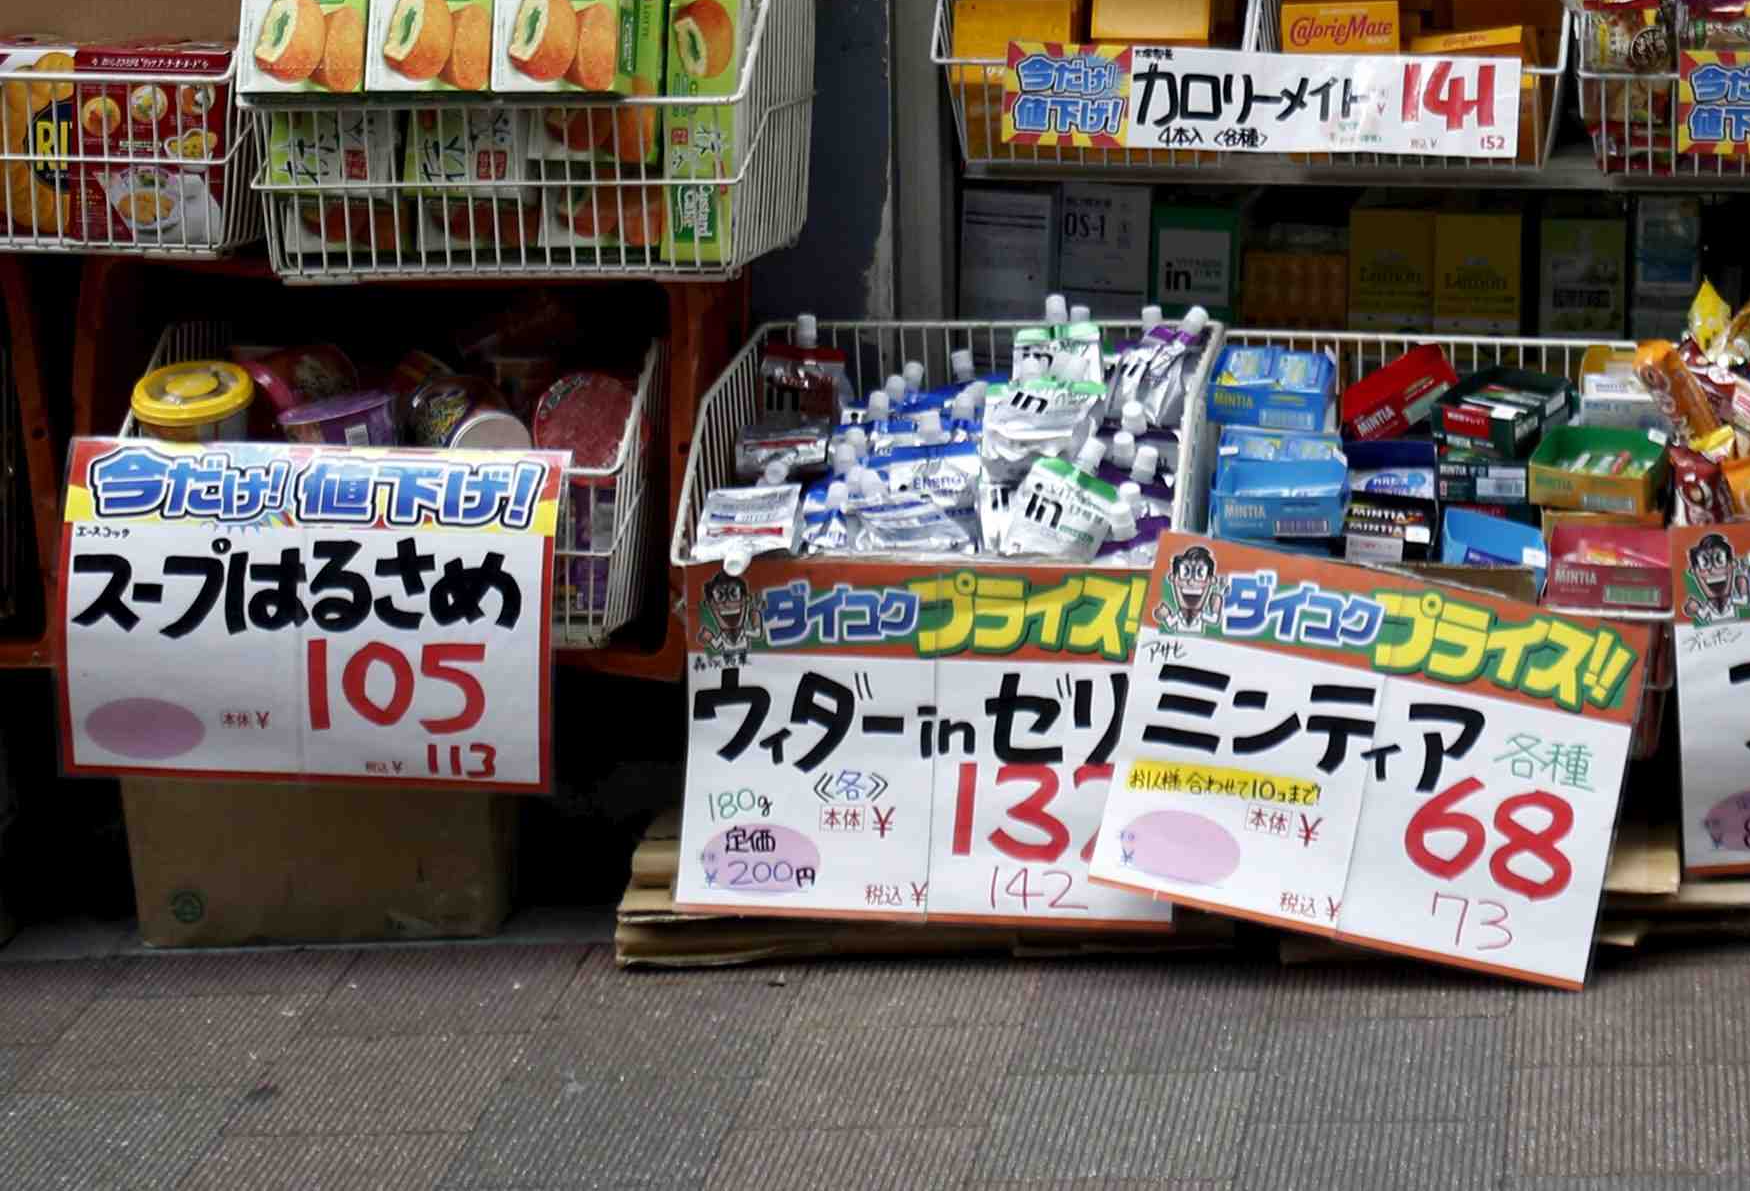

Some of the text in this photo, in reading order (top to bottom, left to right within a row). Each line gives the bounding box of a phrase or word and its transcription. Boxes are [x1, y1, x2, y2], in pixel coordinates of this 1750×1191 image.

[1290, 16, 1392, 47] CalorieMate
[1018, 54, 1117, 95] 今だけ!
[1133, 64, 1369, 126] カロリーメイト
[1401, 60, 1495, 130] 141
[1013, 95, 1122, 135] 値下げ!
[1159, 127, 1204, 148] 4本入
[1480, 137, 1505, 150] 152
[1010, 391, 1050, 415] in
[1214, 390, 1255, 409] MINTIA
[1357, 404, 1397, 439] MINTIA
[95, 449, 538, 526] 今だけ! 値下げ!
[1025, 481, 1064, 531] in
[1224, 504, 1266, 521] MINTIA
[72, 537, 522, 638] スープはるさめ
[1555, 567, 1598, 587] MINTIA
[1143, 638, 1189, 663] アサヒ
[307, 639, 487, 735] 105
[693, 667, 1130, 774] ウィダーinゼリ
[1141, 663, 1486, 794] ミンティア
[426, 744, 497, 778] 113
[1492, 731, 1600, 795] 各種
[708, 788, 774, 820] 180g
[821, 808, 865, 831] 本体
[723, 825, 776, 853] 定価
[1247, 776, 1576, 901] 本体 68
[727, 858, 816, 889] 200円
[865, 867, 1090, 911] 税込 142
[1279, 890, 1515, 953] 税込 73
